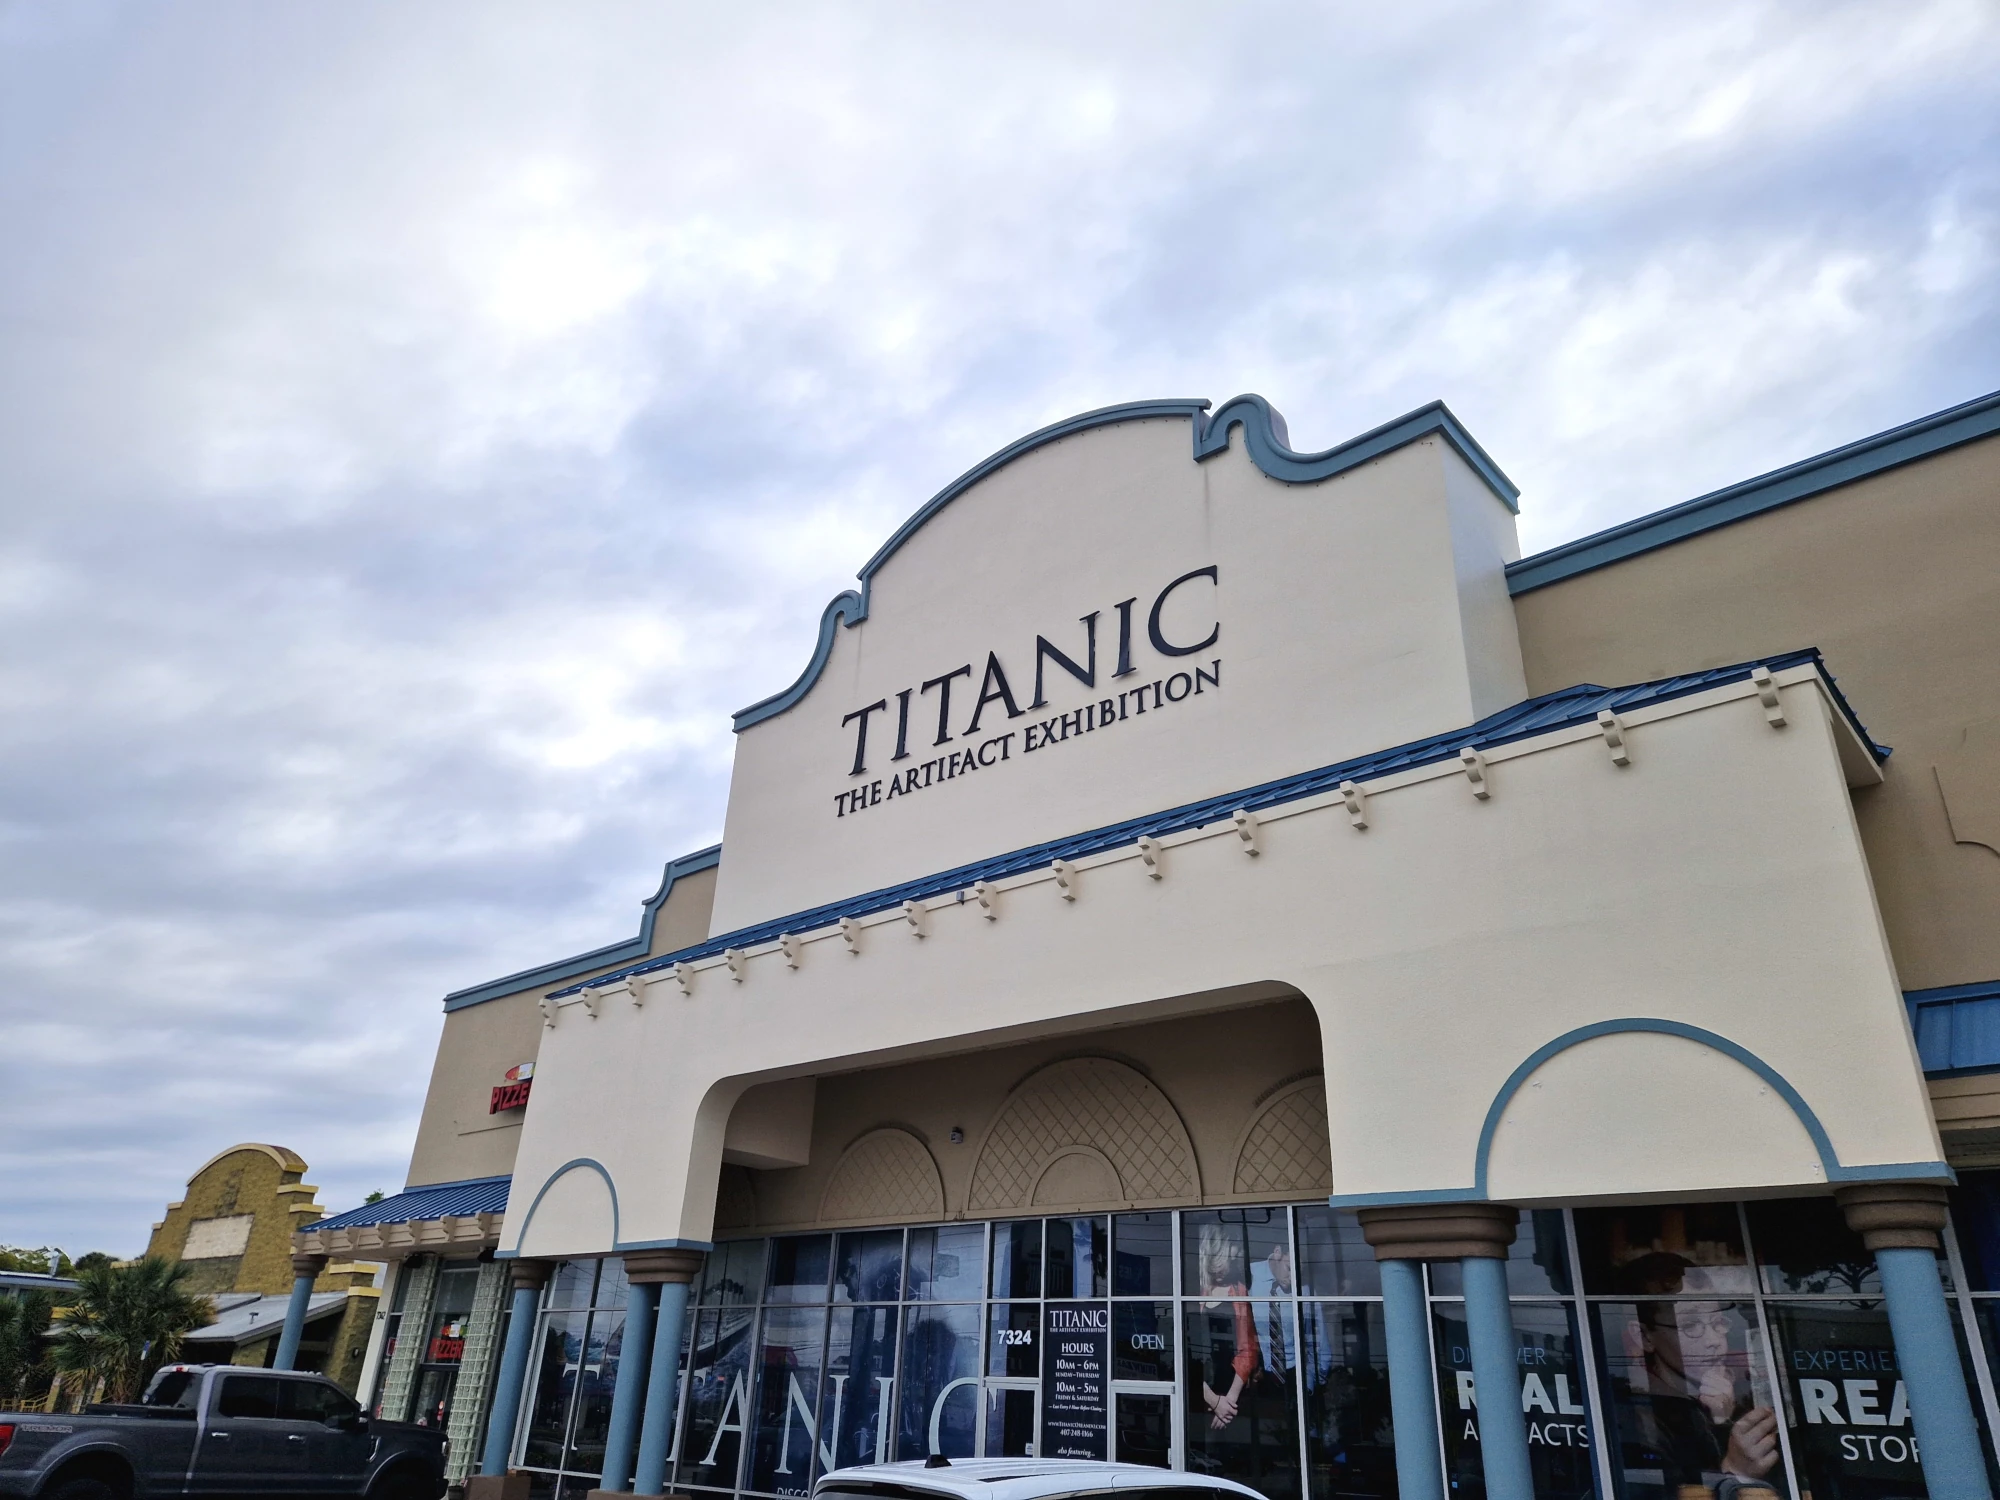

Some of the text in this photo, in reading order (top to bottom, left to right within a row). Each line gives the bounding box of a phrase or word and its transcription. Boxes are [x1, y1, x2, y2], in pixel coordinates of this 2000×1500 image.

[841, 564, 1219, 777] TITANIC
[834, 658, 1221, 818] THE ARTIFACT EXHIBITION
[489, 1081, 531, 1115] PIZZE
[1049, 1309, 1107, 1328] TITANIC
[997, 1329, 1032, 1345] 7324
[1131, 1334, 1165, 1350] OPEN
[1061, 1342, 1094, 1354] HOURS
[1056, 1359, 1076, 1370] 10AM
[1083, 1360, 1099, 1371] 6PM
[1793, 1350, 1900, 1371] EXPERIE
[1056, 1381, 1076, 1392] 10AM
[1084, 1382, 1099, 1394] 5PM
[1456, 1370, 1585, 1415] RAL
[562, 1362, 998, 1474] TTANIC
[1463, 1418, 1590, 1448] AACTS
[1057, 1446, 1067, 1455] also
